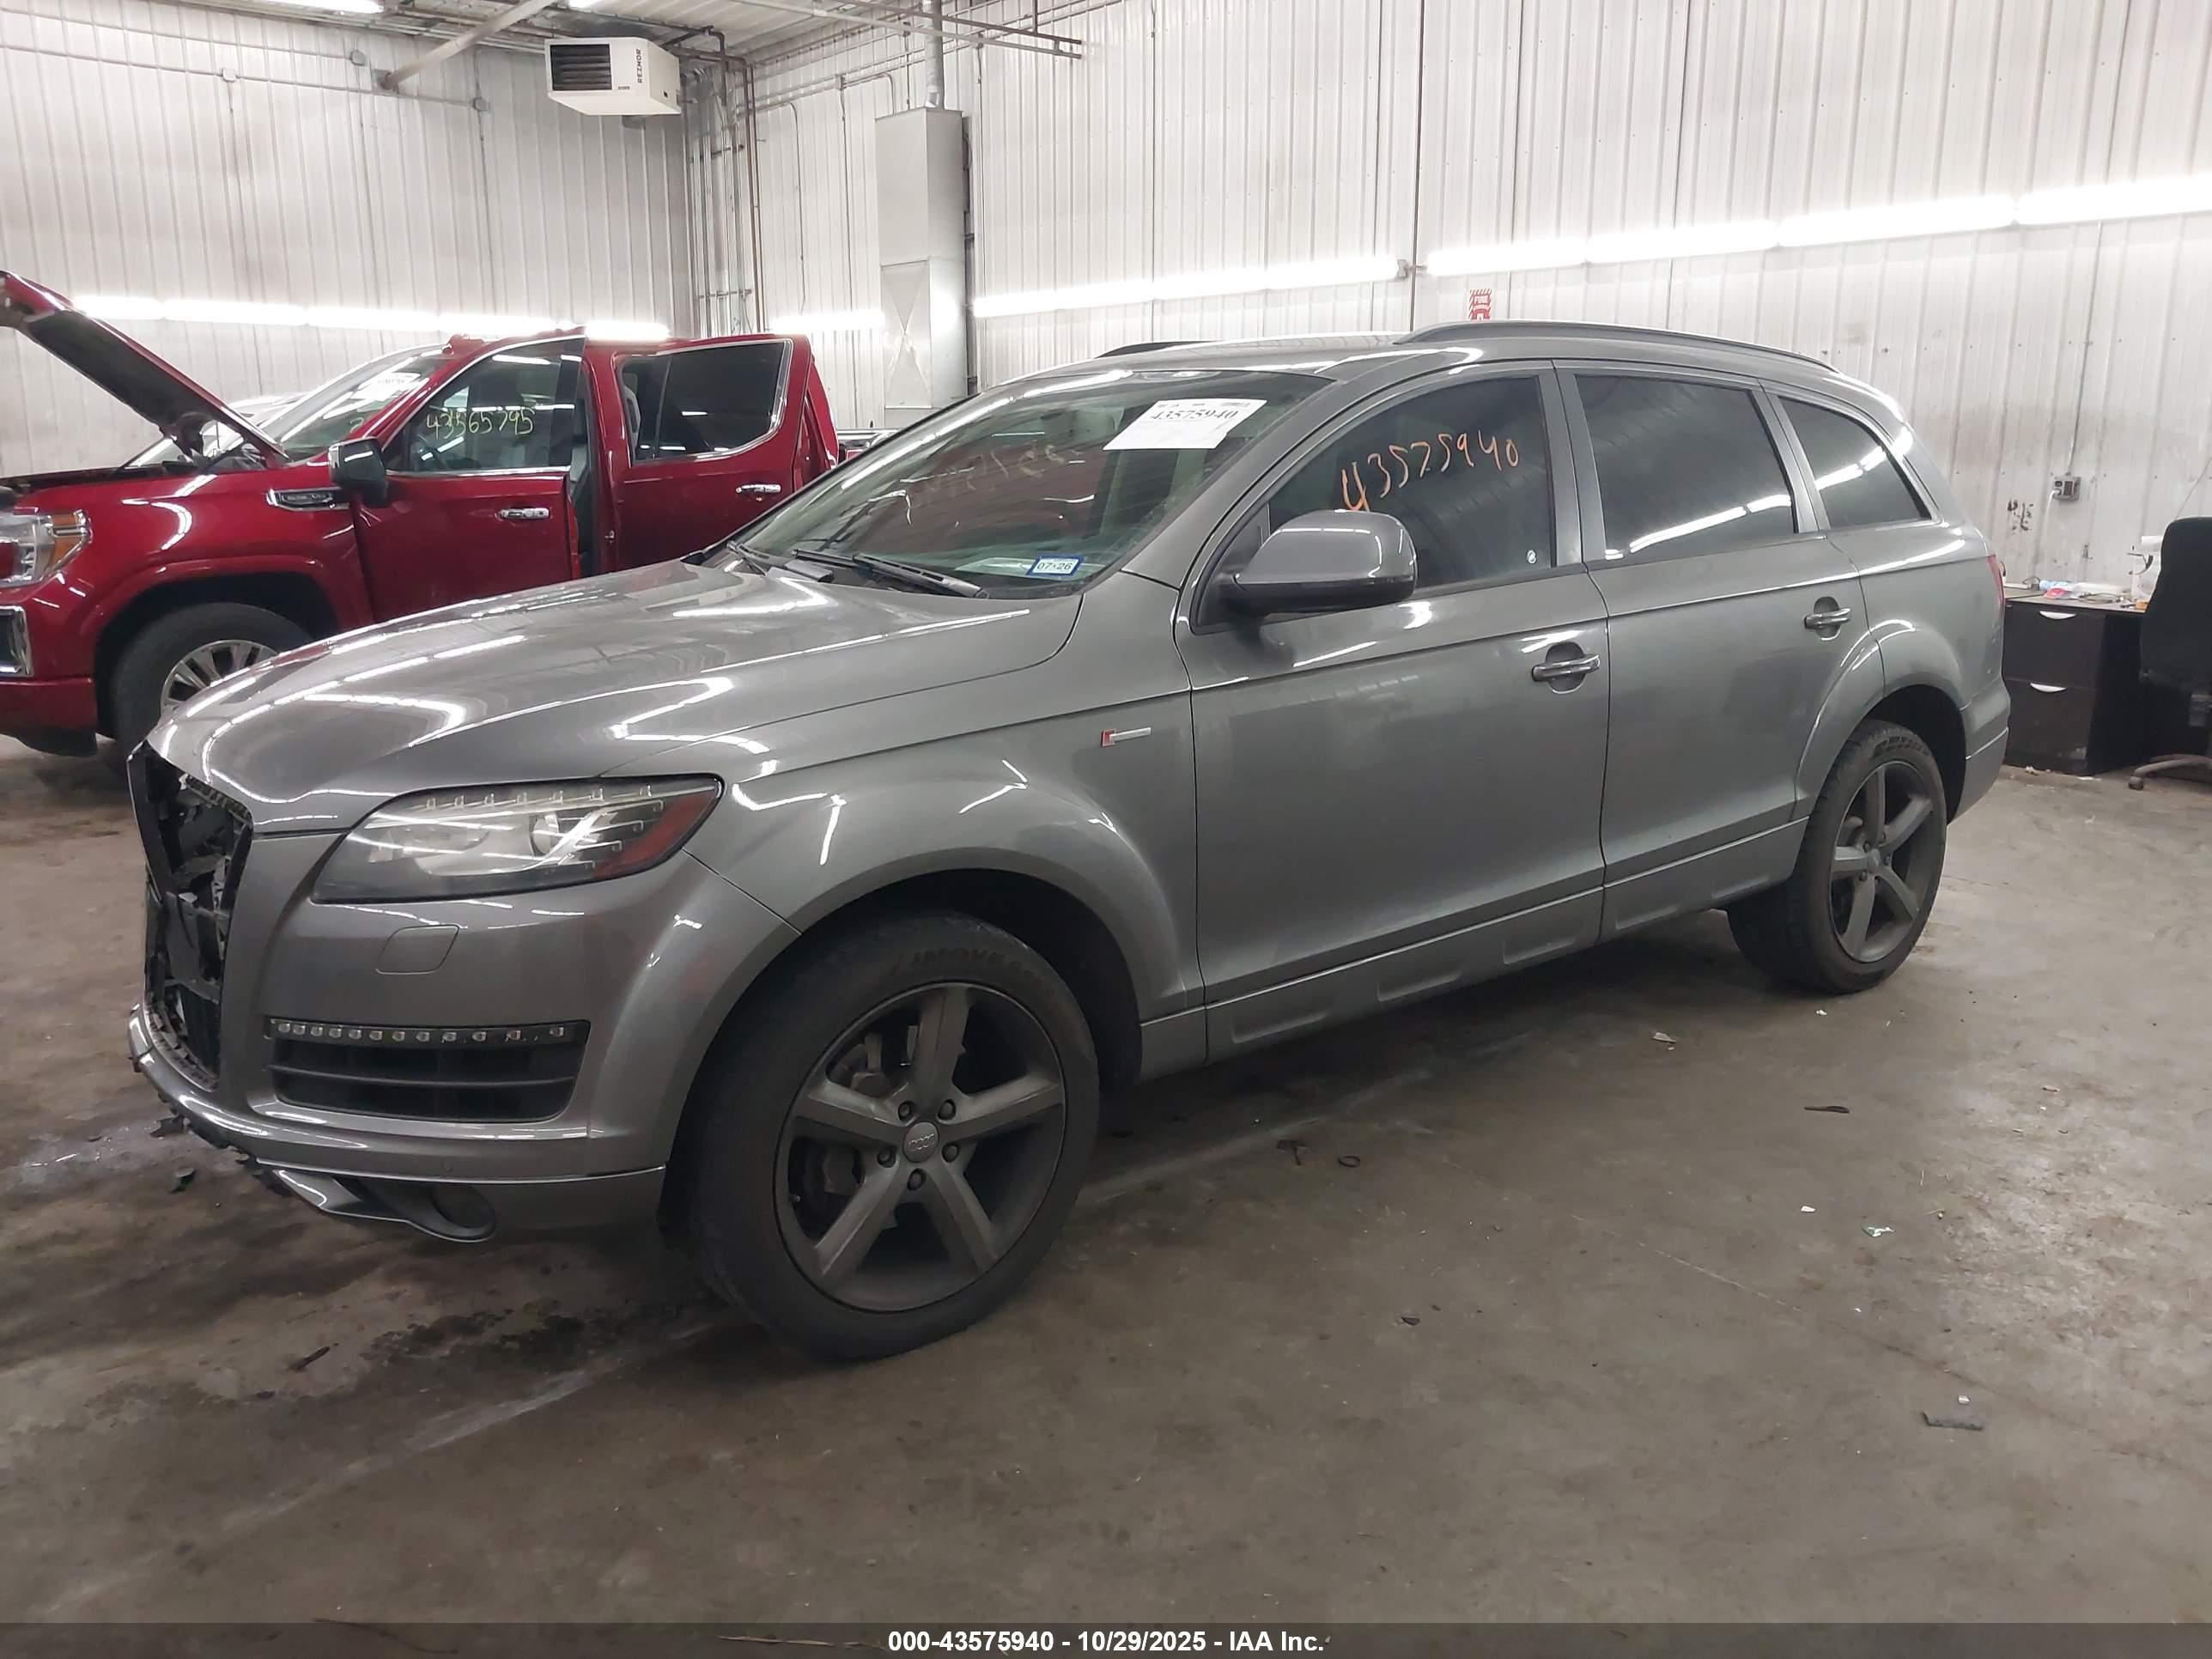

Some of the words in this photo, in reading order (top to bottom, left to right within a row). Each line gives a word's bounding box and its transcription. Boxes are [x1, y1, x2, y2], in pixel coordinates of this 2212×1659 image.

[1474, 295, 1488, 304] FIRE
[427, 407, 535, 440] 43565795
[1151, 410, 1239, 420] 43575940
[1341, 429, 1519, 512] 43575940
